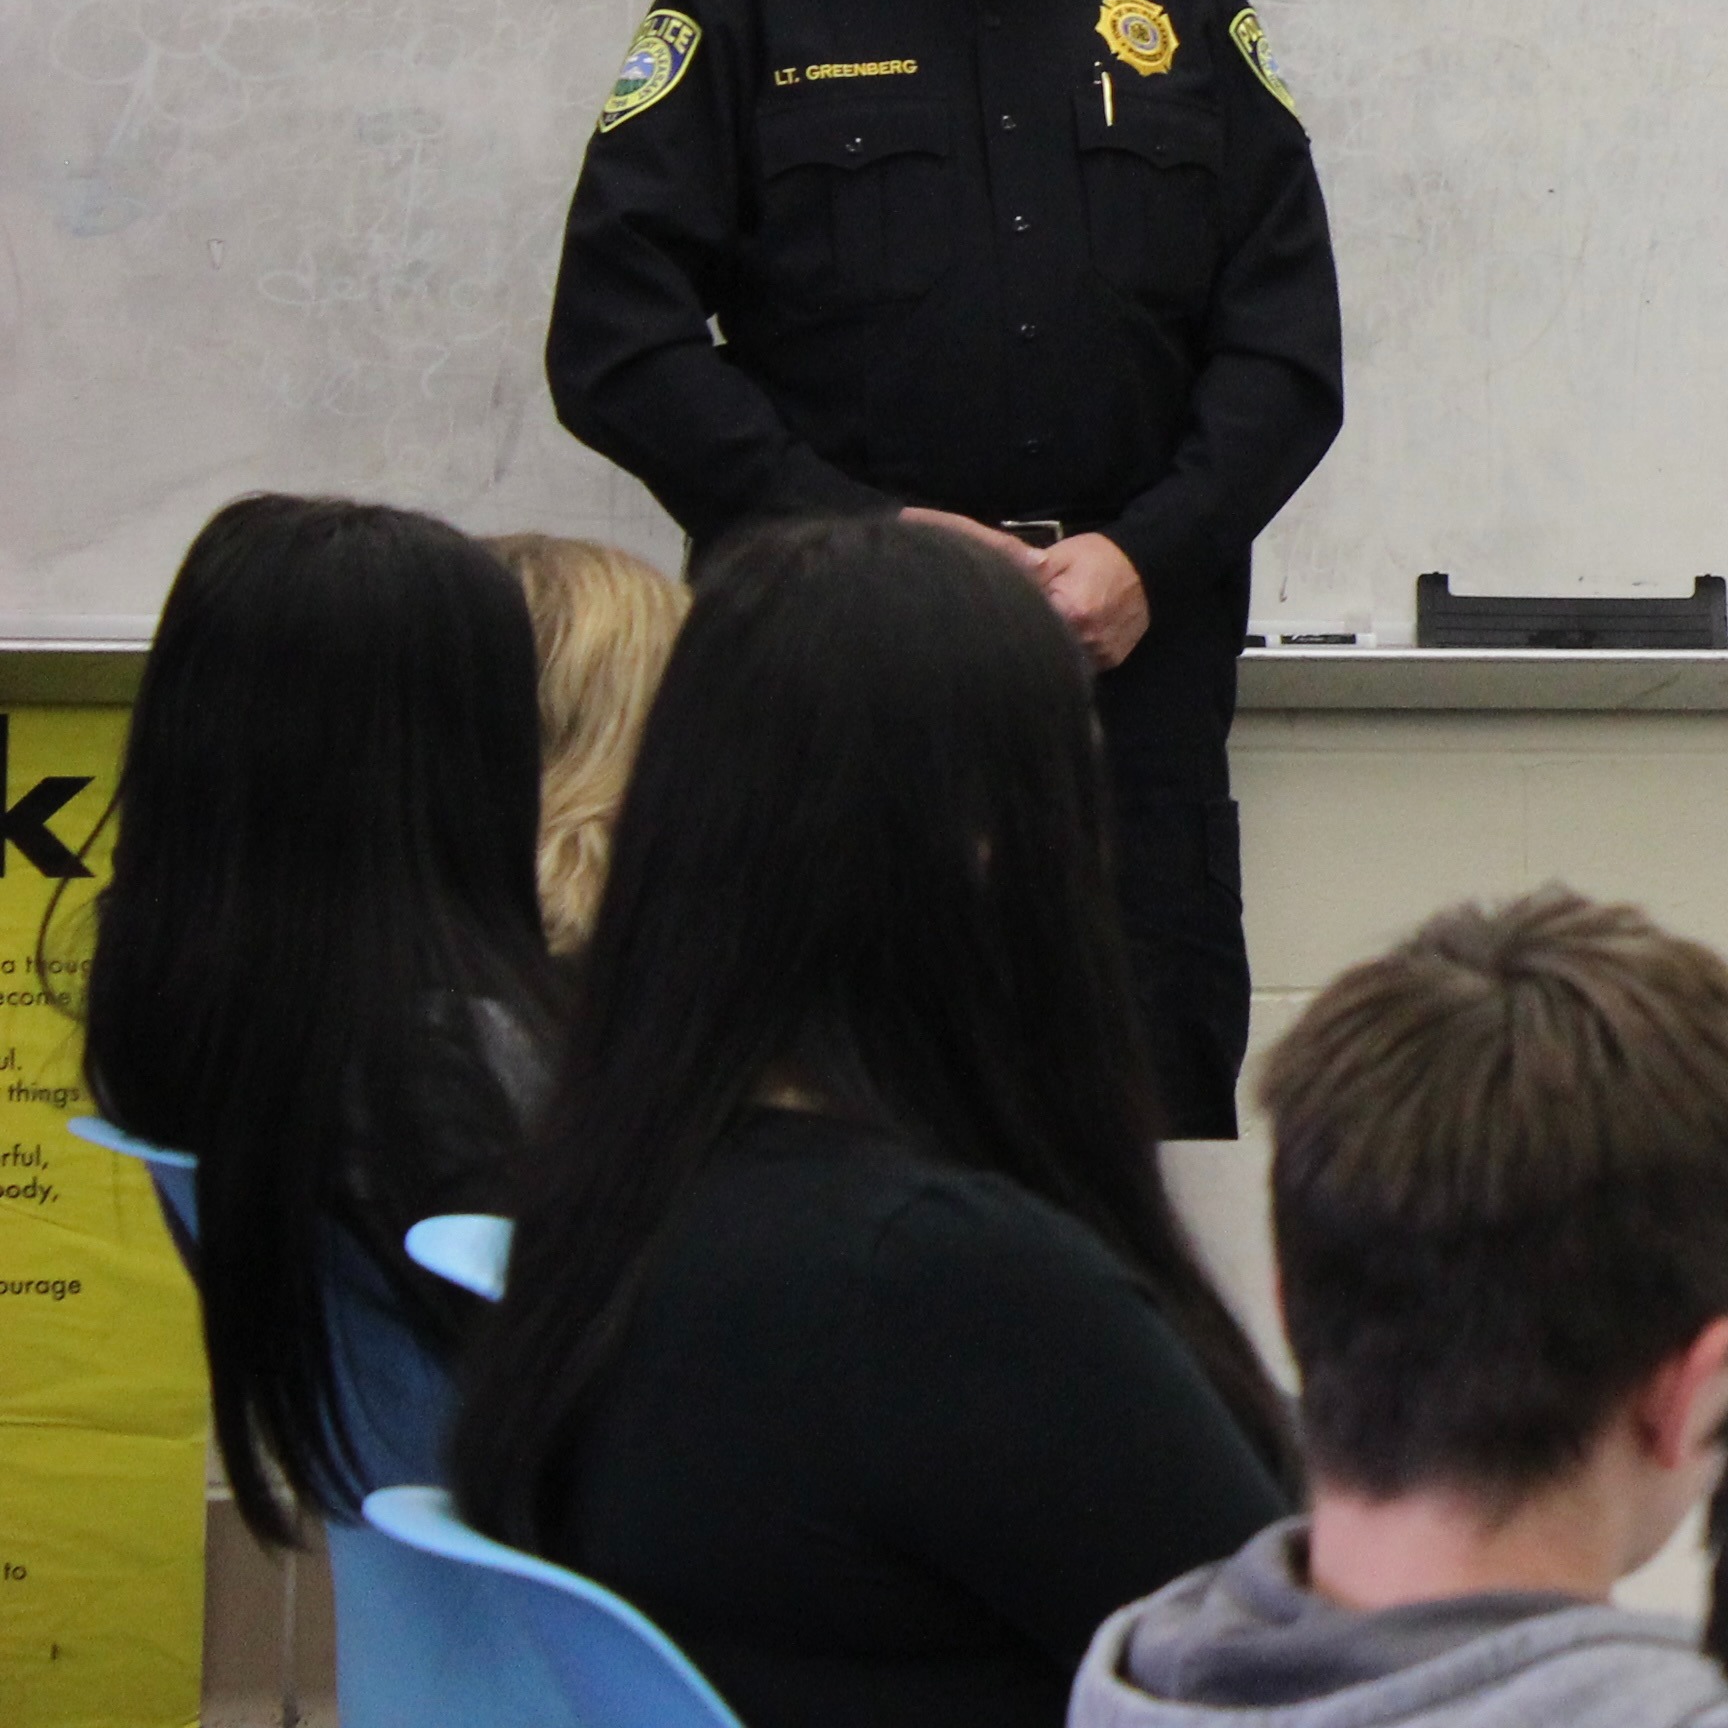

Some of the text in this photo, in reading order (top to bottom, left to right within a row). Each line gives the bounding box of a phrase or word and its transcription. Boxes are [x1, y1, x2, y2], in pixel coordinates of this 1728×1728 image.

[774, 60, 918, 86] LT. GREENBERG
[4, 1562, 27, 1580] to
